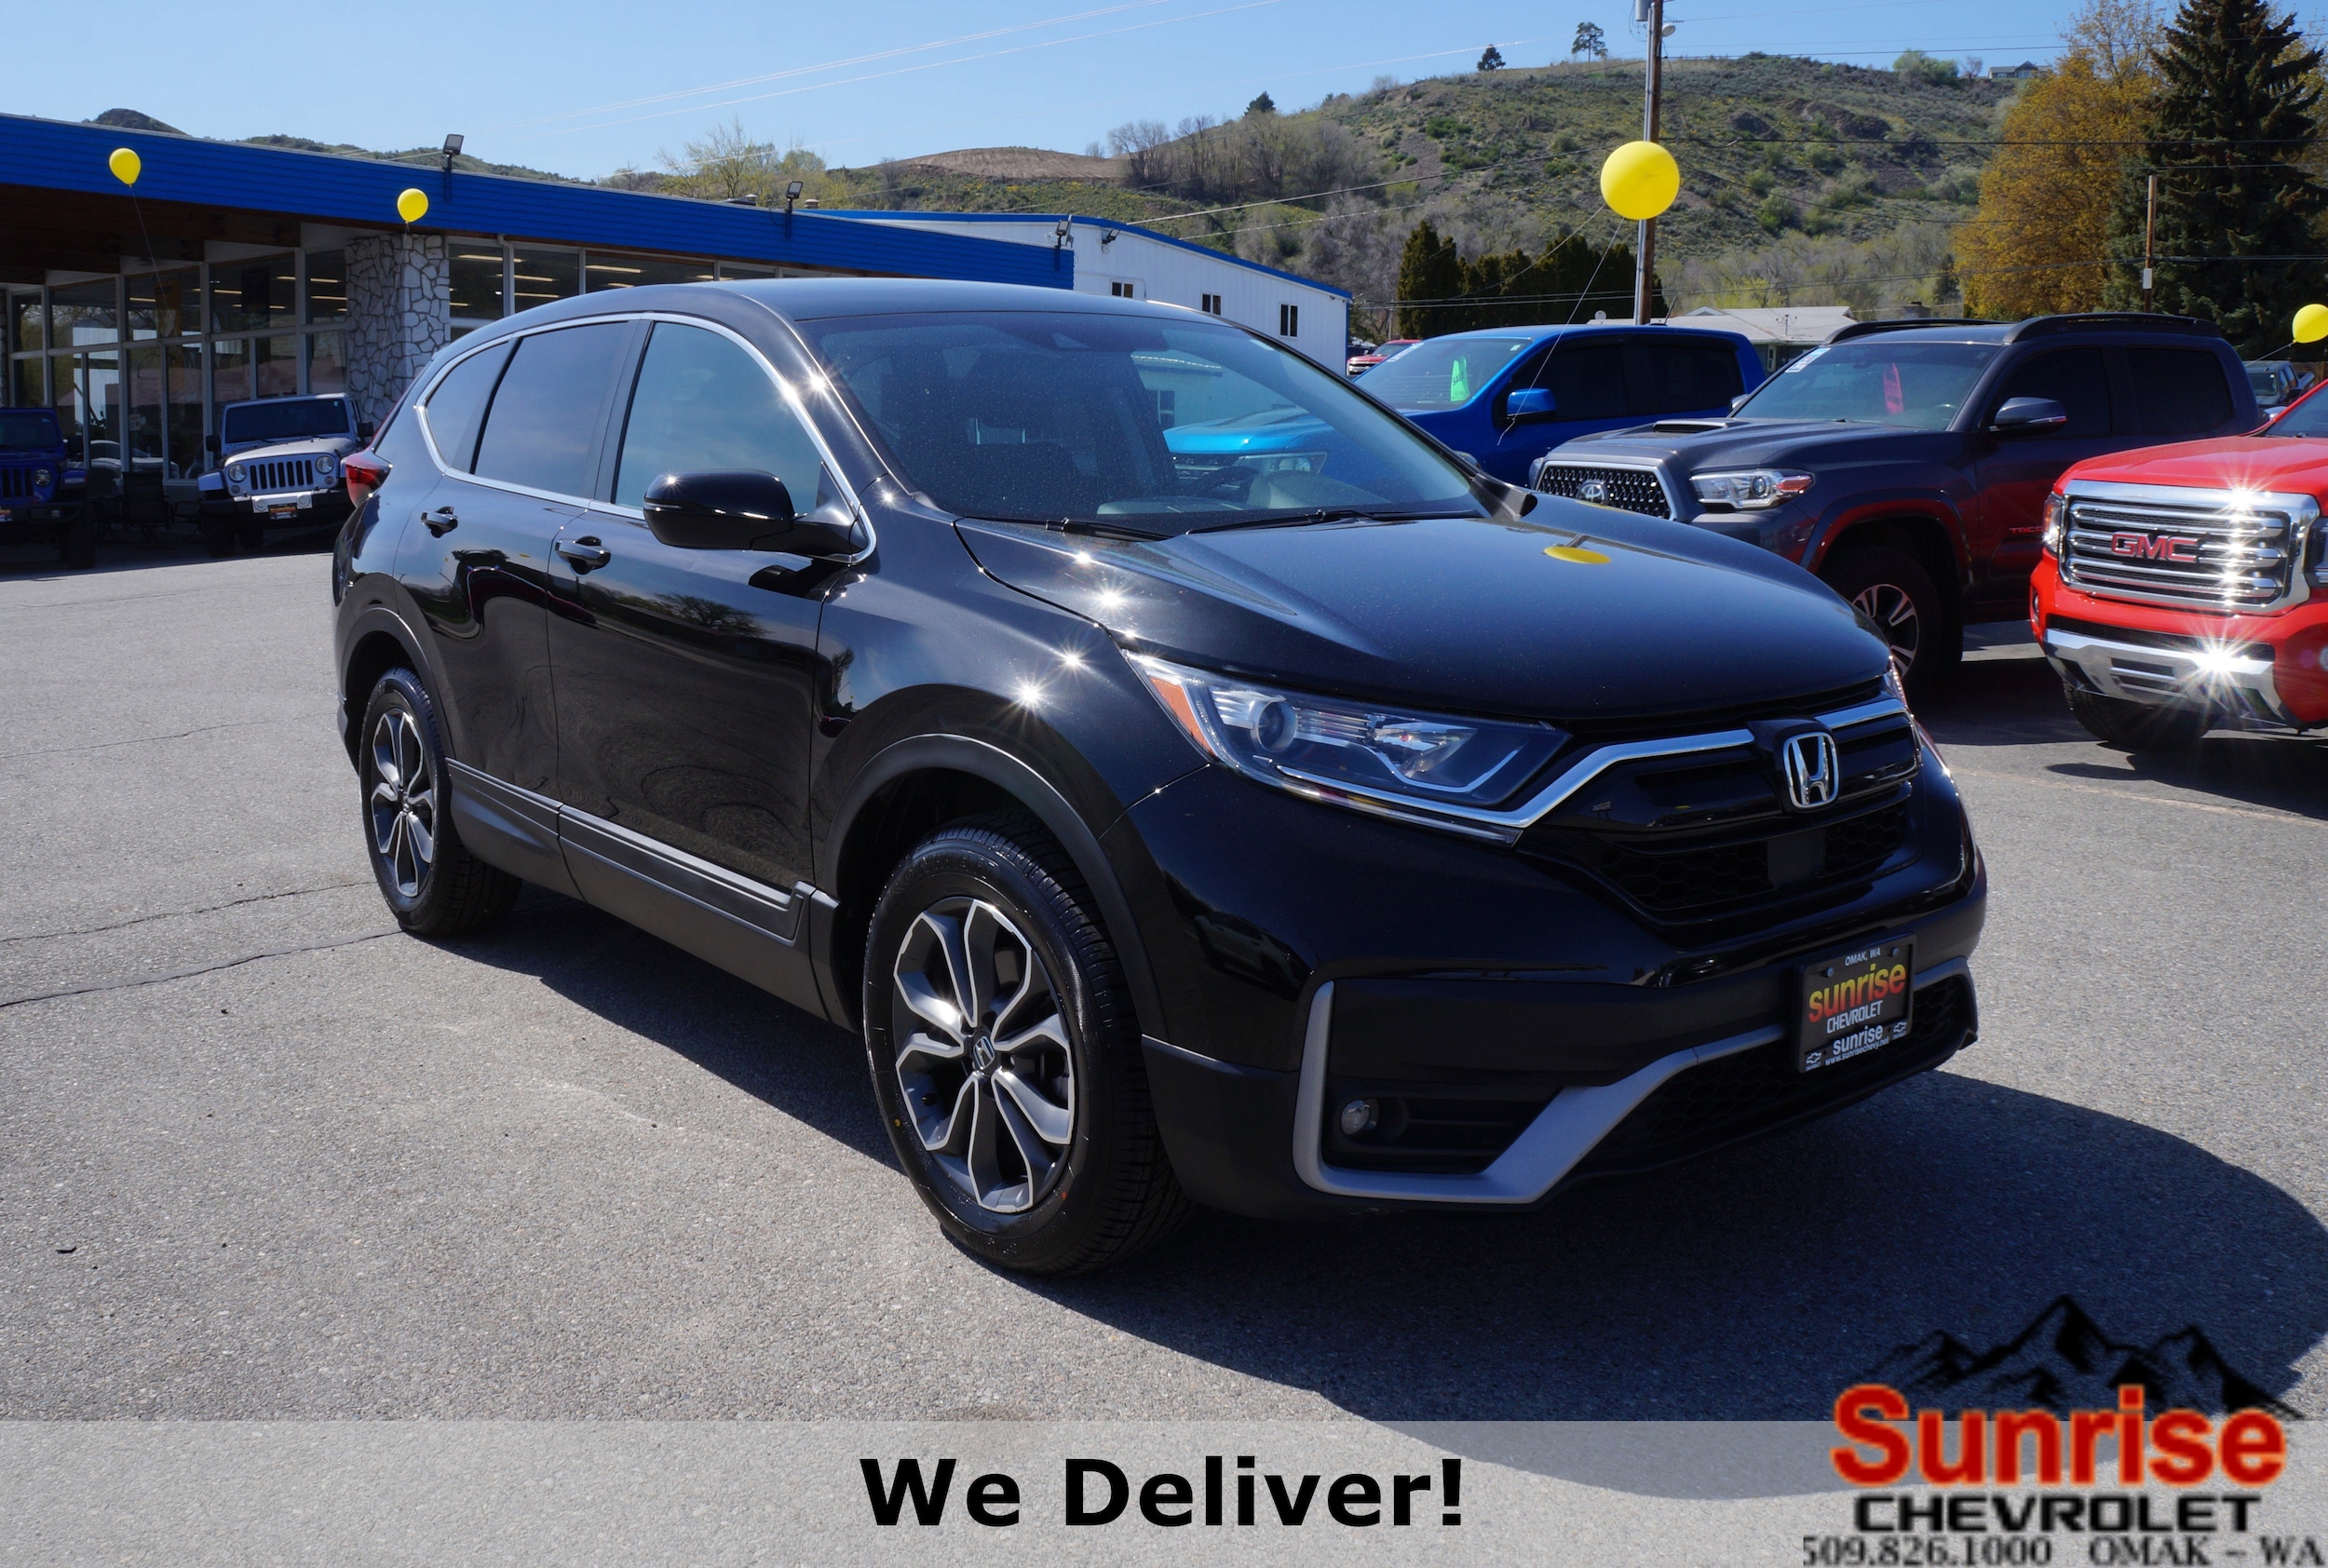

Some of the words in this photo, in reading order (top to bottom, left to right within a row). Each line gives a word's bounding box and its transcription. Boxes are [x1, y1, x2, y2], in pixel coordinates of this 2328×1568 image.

[2111, 532, 2201, 563] GMC
[1869, 947, 1881, 959] WA
[1808, 963, 1906, 1023] sunrise
[1826, 1000, 1883, 1034] CHEVROLET
[1833, 1025, 1884, 1056] sunrise
